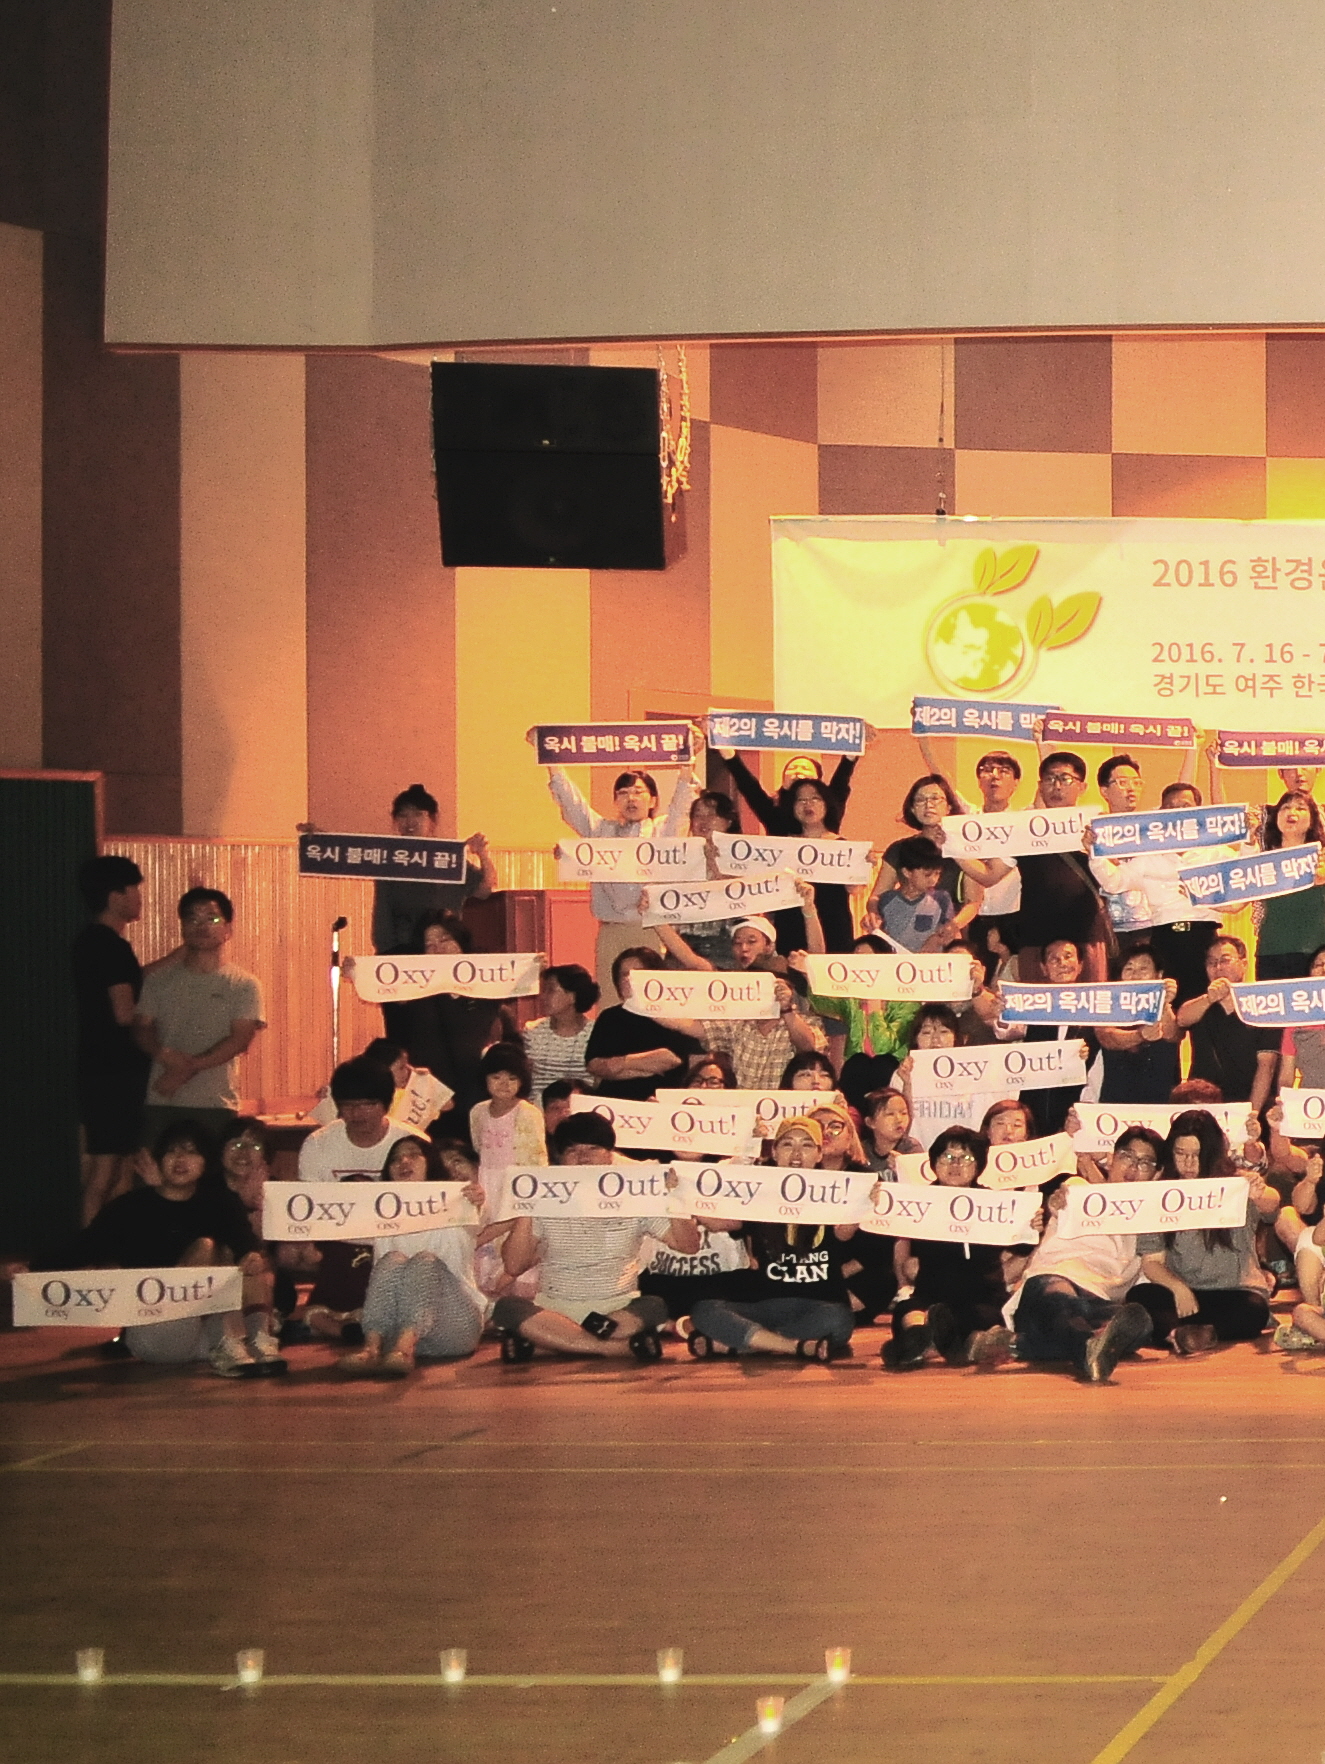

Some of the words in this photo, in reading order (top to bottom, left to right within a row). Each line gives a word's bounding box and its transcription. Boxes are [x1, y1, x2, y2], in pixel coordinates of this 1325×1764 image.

[1152, 559, 1238, 588] 2016
[1152, 642, 1224, 663] 2016.
[1153, 673, 1226, 698] 경기도
[1235, 673, 1283, 699] 여주
[713, 715, 756, 738] 제2의
[763, 718, 814, 742] 옥시를
[820, 723, 860, 743] 막자!
[1047, 719, 1081, 733] 옥시
[1087, 720, 1124, 734] 불매!
[1129, 723, 1161, 737] 옥시
[1166, 724, 1188, 737] 끝!
[544, 736, 576, 753] 옥시
[582, 736, 619, 753] 불매!
[623, 735, 656, 752] 옥시
[661, 734, 684, 751] 끝!
[961, 820, 1014, 844] Oxy
[1029, 813, 1085, 838] Out!
[1096, 824, 1140, 846] 제2의
[1147, 819, 1198, 841] 옥시를
[1206, 812, 1246, 834] 막자!
[306, 846, 339, 863] 옥시
[346, 849, 387, 864] 불매!
[393, 850, 427, 867] 옥시
[433, 852, 457, 869] 끝!
[731, 840, 783, 868] Oxy
[797, 844, 852, 868] Out!
[375, 962, 435, 990] Oxy
[452, 960, 516, 984] Out!
[827, 962, 880, 987] Oxy
[895, 962, 953, 984] Out!
[644, 979, 694, 1005] Oxy
[708, 980, 761, 1002] Out!
[1006, 993, 1051, 1012] 제2의
[1059, 991, 1112, 1013] 옥시를
[1120, 992, 1161, 1012] 막자!
[933, 1055, 988, 1079] Oxy
[1004, 1049, 1063, 1074] Out!
[697, 1169, 762, 1202] Oxy
[780, 1173, 850, 1204] Out!
[288, 1194, 355, 1225] Oxy
[375, 1191, 447, 1219] Out!
[1083, 1193, 1143, 1220] Oxy
[1162, 1188, 1224, 1212] Out!
[42, 1280, 116, 1311] Oxy
[137, 1276, 213, 1306] Out!
